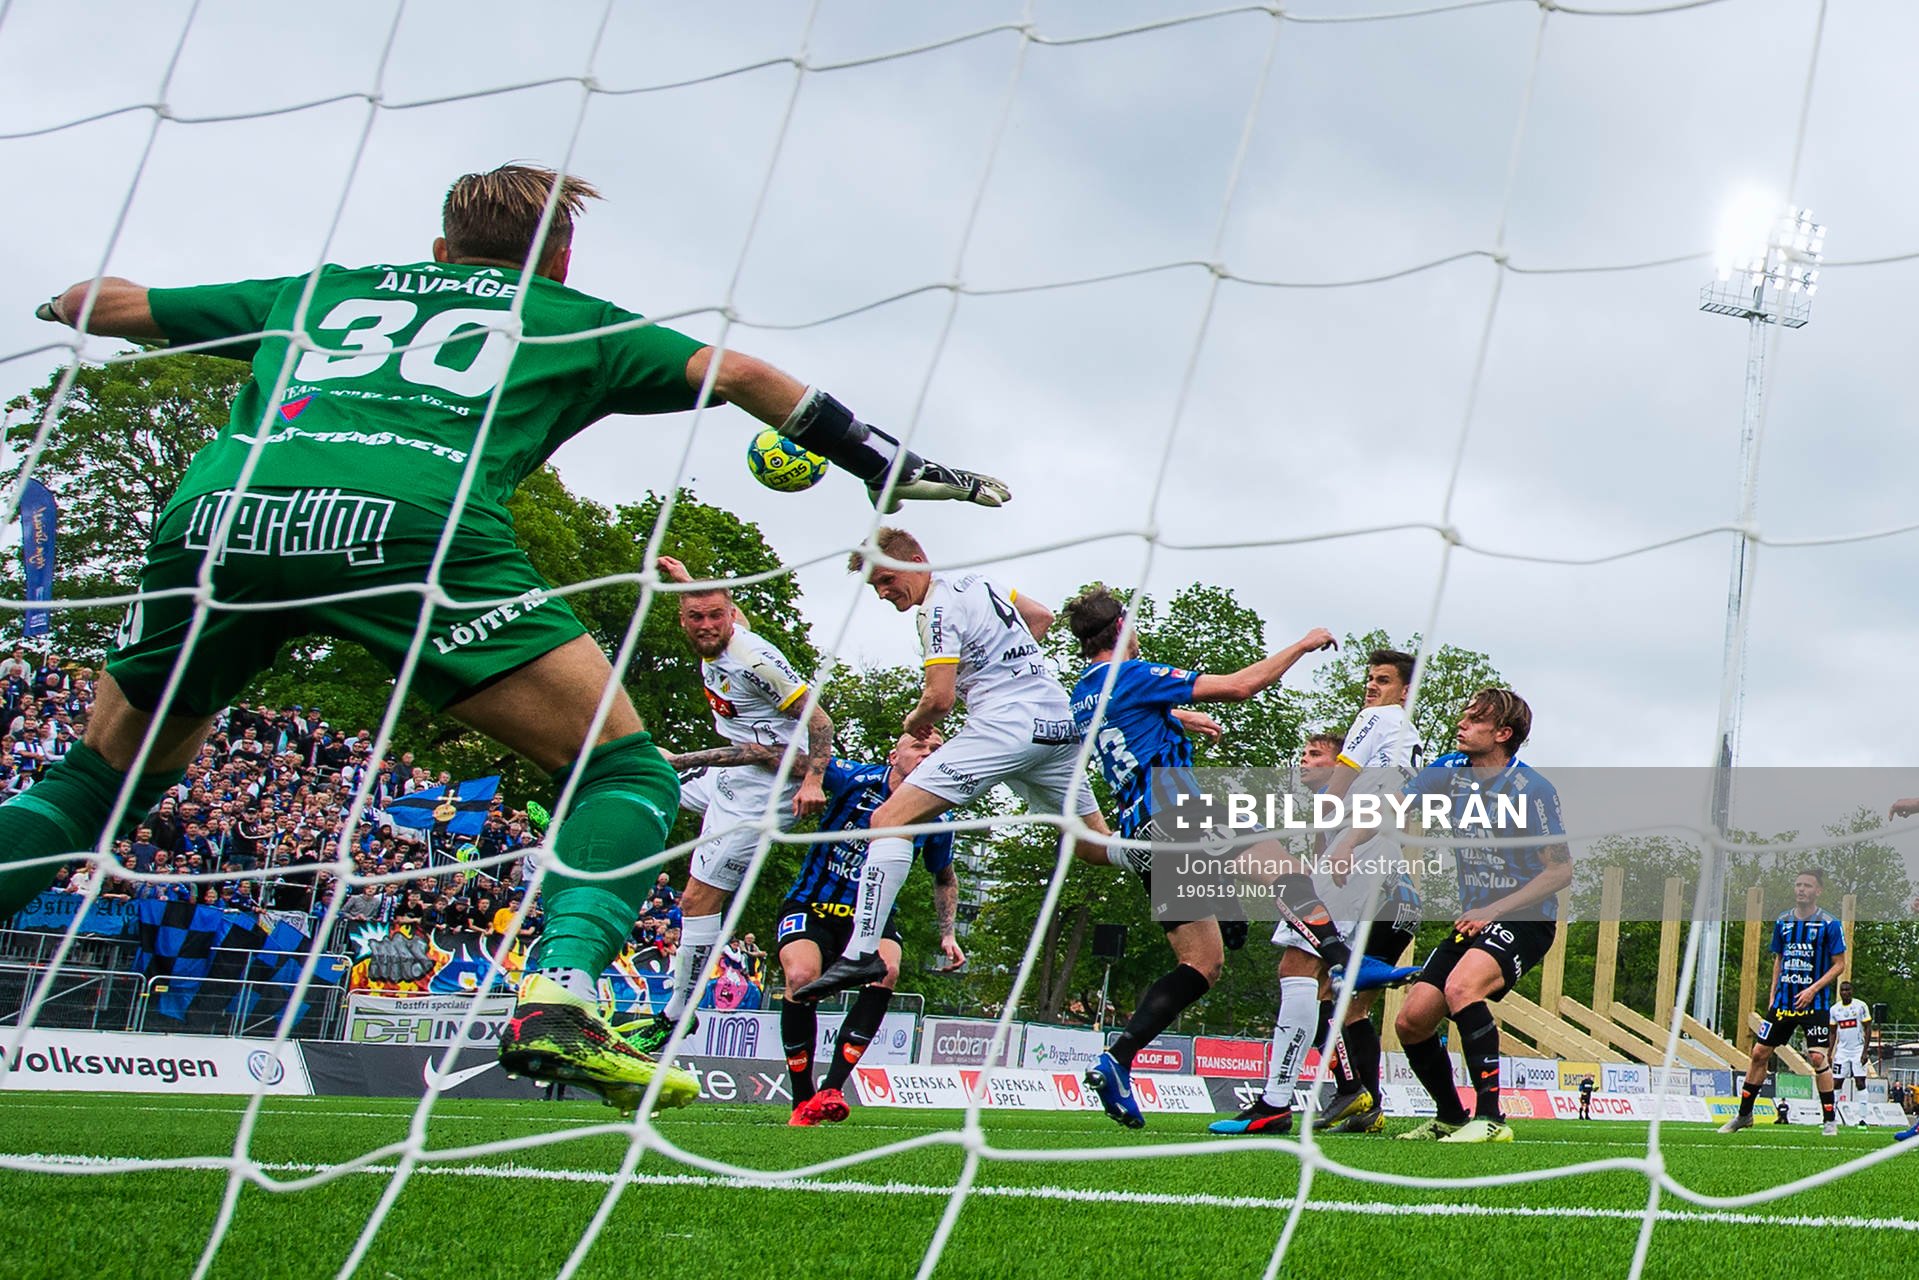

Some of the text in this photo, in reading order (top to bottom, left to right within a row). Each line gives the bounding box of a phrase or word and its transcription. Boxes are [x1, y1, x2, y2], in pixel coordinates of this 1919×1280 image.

[293, 299, 514, 397] 30
[432, 602, 521, 655] LÖJTE
[932, 606, 943, 653] stadium
[741, 669, 782, 703] stadium
[1347, 714, 1380, 752] stadium
[1464, 871, 1518, 889] inkClub
[395, 1001, 429, 1009] Rostfri
[434, 1020, 506, 1042] INOX
[1807, 1026, 1829, 1036] xite
[1049, 1045, 1097, 1065] ByggPartner
[1137, 1053, 1179, 1065] OLOF BIL
[0, 1046, 218, 1083] Volkswagen
[1196, 1055, 1263, 1072] TRANSSCHAKT
[893, 1075, 957, 1090] SVENSKA
[1618, 1070, 1640, 1083] LIBRO
[990, 1078, 1047, 1092] SVENSKA
[1158, 1084, 1205, 1098] SVENSKA
[899, 1091, 934, 1105] SPEL
[996, 1094, 1026, 1107] SPEL
[1164, 1098, 1190, 1110] SPEL
[1554, 1096, 1579, 1112] RA
